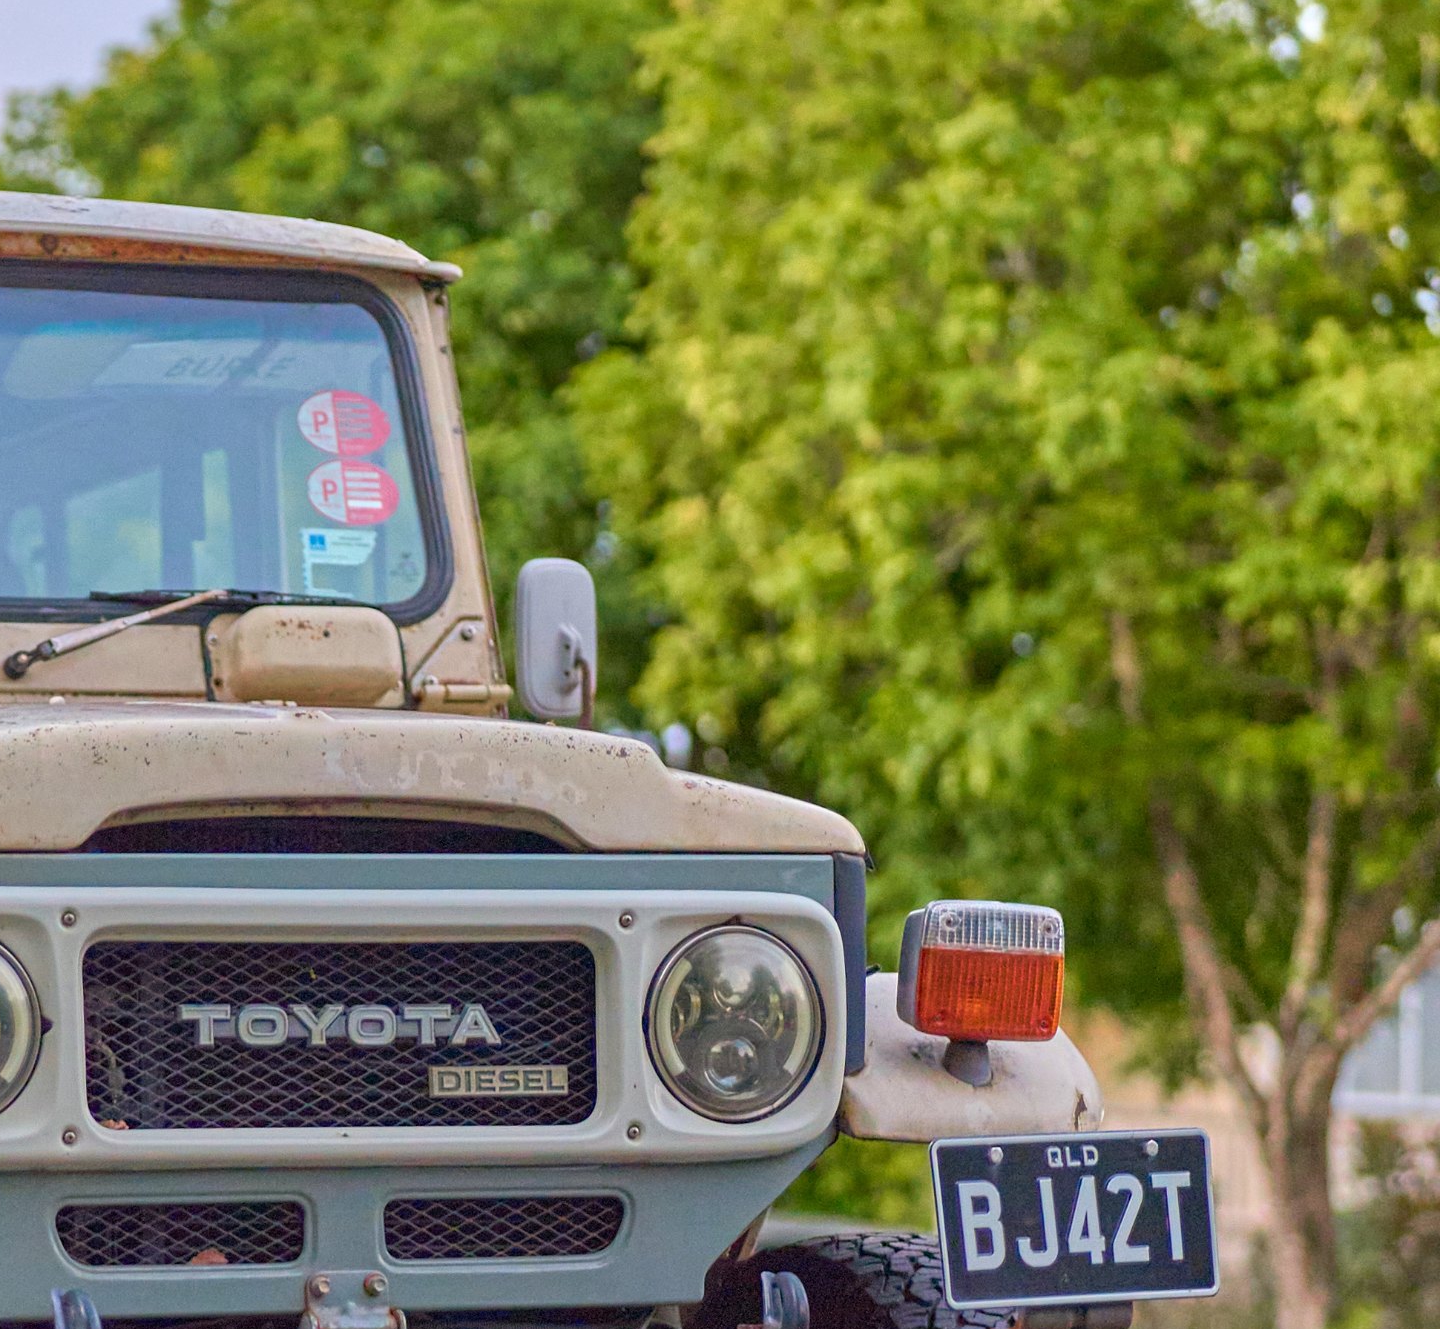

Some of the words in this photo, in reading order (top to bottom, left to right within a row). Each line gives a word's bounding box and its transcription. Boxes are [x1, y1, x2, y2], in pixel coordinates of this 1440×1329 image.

[312, 410, 329, 434] P
[322, 478, 338, 502] P
[178, 1002, 503, 1047] TOYOTA
[437, 1069, 567, 1094] DIESEL
[1046, 1145, 1100, 1168] QLD
[956, 1170, 1192, 1272] BJ42T
